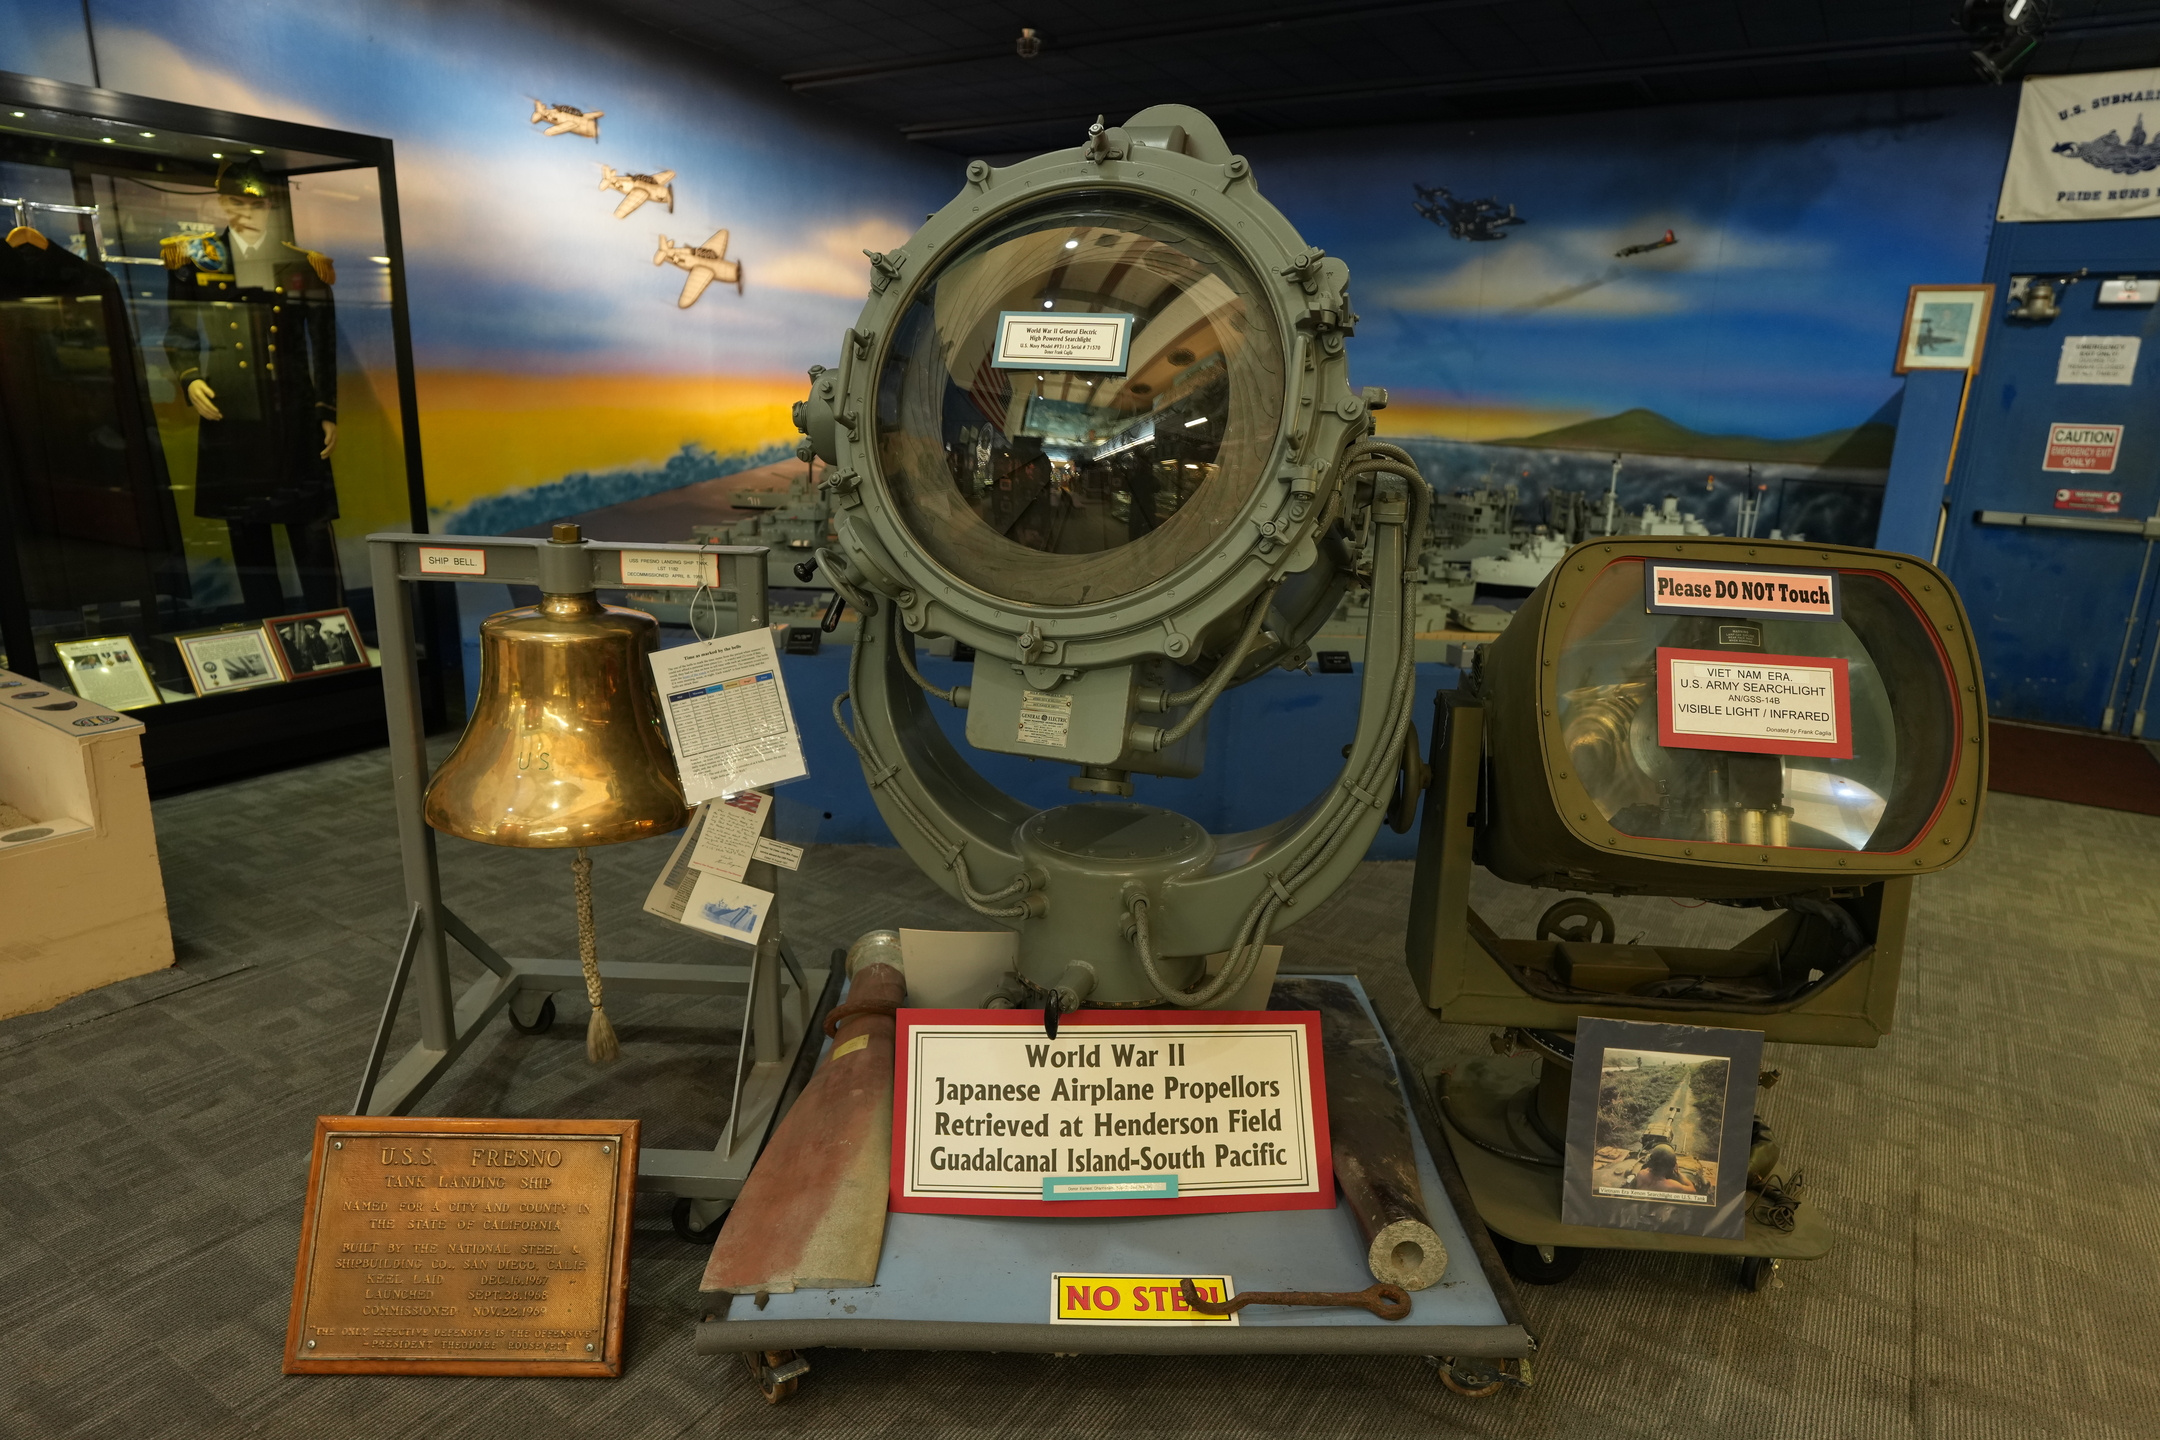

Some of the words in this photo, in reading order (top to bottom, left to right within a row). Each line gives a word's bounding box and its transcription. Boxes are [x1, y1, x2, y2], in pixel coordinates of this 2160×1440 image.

[2058, 105, 2086, 120] U.S.
[2057, 191, 2101, 201] PRIDE
[2108, 188, 2149, 200] RUNS
[2055, 430, 2114, 442] CAUTION
[2051, 446, 2095, 456] EMERGENCY
[2096, 448, 2112, 457] EXIT
[2063, 457, 2096, 467] ONLY!
[429, 556, 449, 564] SHIP
[1658, 577, 1711, 598] Please
[1715, 580, 1738, 599] DO
[1742, 582, 1774, 600] NOT
[1779, 584, 1830, 604] Touch
[1707, 668, 1731, 677] VIET
[1738, 670, 1762, 679] NAM
[1768, 672, 1792, 681] ERA.
[1681, 679, 1702, 688] U.S.
[1706, 681, 1740, 691] ARMY
[1743, 683, 1826, 696] SEARCHLIGHT
[1728, 694, 1780, 704] AN/GSS-14B
[1678, 704, 1722, 714] VISIBLE
[1726, 706, 1760, 717] LIGHT
[1770, 709, 1830, 721] INFRARED
[1025, 1044, 1100, 1068] World
[1111, 1044, 1158, 1067] War
[1169, 1044, 1185, 1066] II
[935, 1077, 1040, 1105] Japanese
[1051, 1077, 1154, 1106] Airplane
[1165, 1075, 1280, 1103] Propellors
[935, 1112, 1049, 1137] Retrieved
[1060, 1116, 1083, 1137] at
[1094, 1112, 1218, 1136] Henderson
[1229, 1108, 1282, 1132] Field
[381, 1147, 437, 1166] U.S.S.
[471, 1148, 562, 1168] FRESNO
[930, 1146, 1057, 1172] Guadalcanal
[1068, 1145, 1204, 1172] Island-South
[1215, 1142, 1287, 1167] Pacific
[385, 1175, 426, 1188] TANK
[438, 1176, 506, 1189] LANDING
[520, 1177, 553, 1189] SHIP
[342, 1201, 388, 1211] NAMED
[399, 1202, 424, 1212] FOR
[431, 1202, 439, 1212] A
[449, 1202, 478, 1212] CITY
[483, 1203, 510, 1213] AND
[519, 1203, 570, 1213] COUNTY
[578, 1204, 592, 1214] IN
[370, 1219, 395, 1229] THE
[407, 1220, 446, 1230] STATE
[457, 1220, 475, 1230] OF
[483, 1220, 562, 1231] CALIFORNIA
[342, 1243, 380, 1253] BUILT
[388, 1243, 405, 1253] BY
[413, 1244, 438, 1254] THE
[447, 1244, 511, 1255] NATIONAL
[521, 1245, 561, 1255] STEEL
[572, 1245, 581, 1254] &
[335, 1258, 422, 1269] SHIPBUILDING
[463, 1260, 488, 1270] SAN
[498, 1261, 539, 1271] DIEGO,
[547, 1261, 587, 1271] CALIF.
[366, 1274, 403, 1284] KEEL
[413, 1274, 444, 1285] LAID
[365, 1289, 434, 1300] LAUNCHED
[1066, 1286, 1120, 1311] NO
[362, 1306, 457, 1316] COMMISSIONED
[342, 1327, 369, 1336] ONLY
[374, 1328, 429, 1336] EFFECTIVE
[434, 1328, 490, 1337] DEFENSIVE
[496, 1329, 505, 1337] IS
[511, 1329, 530, 1337] THE
[441, 1341, 496, 1349] THEODORE
[508, 1342, 572, 1351] ROOSEVELT
